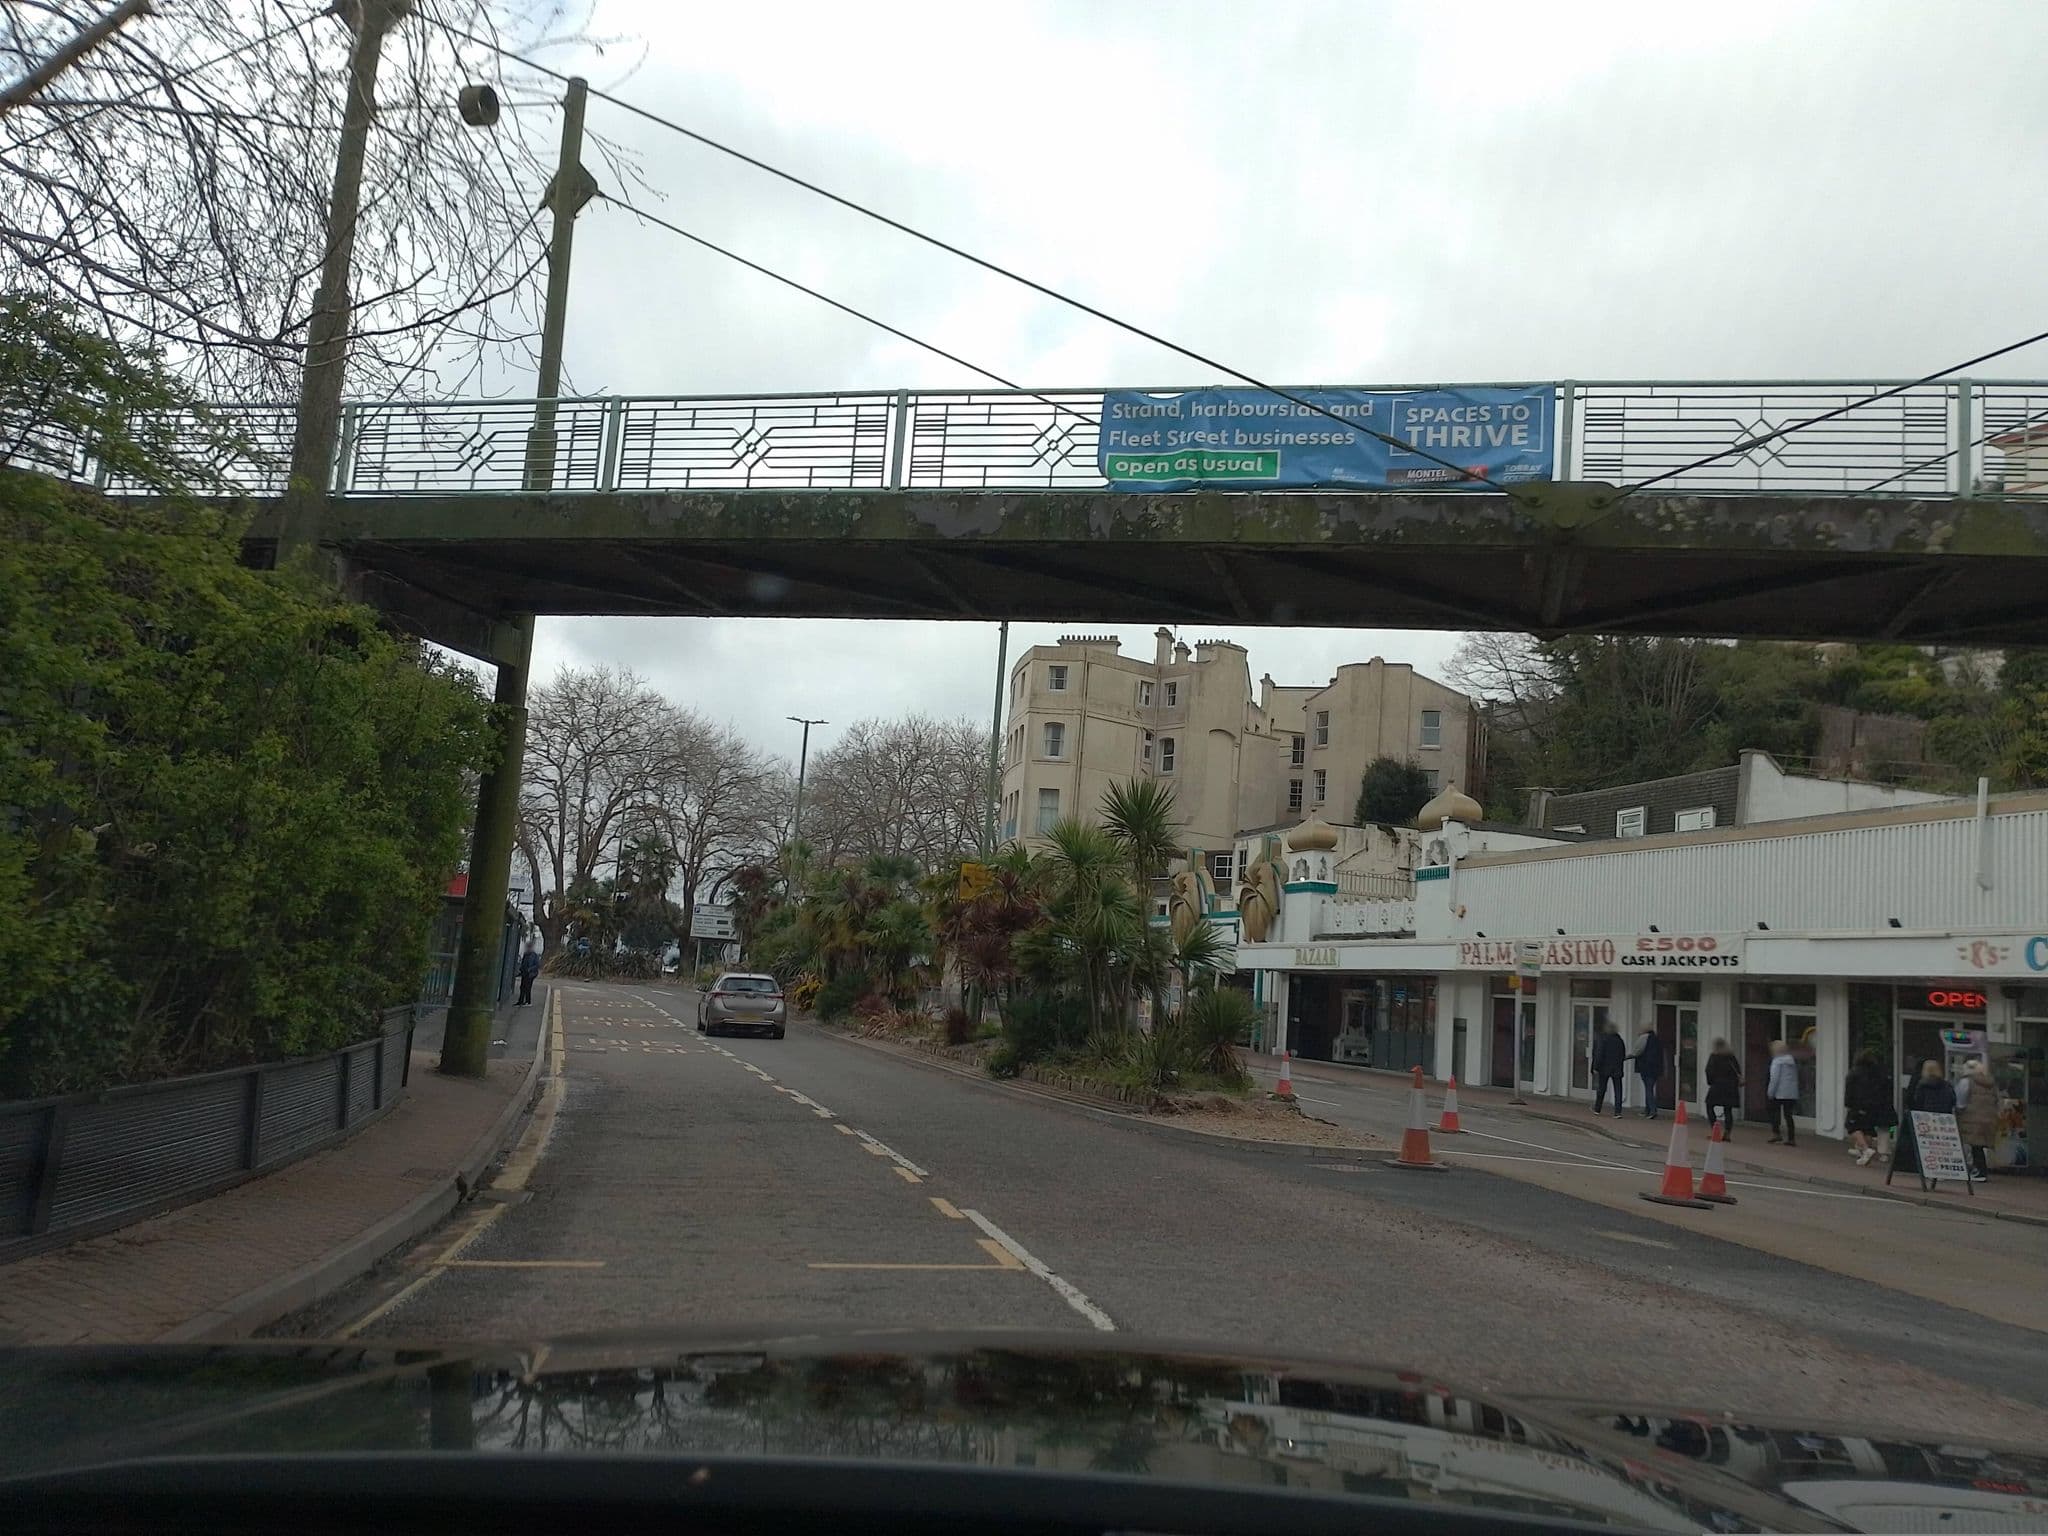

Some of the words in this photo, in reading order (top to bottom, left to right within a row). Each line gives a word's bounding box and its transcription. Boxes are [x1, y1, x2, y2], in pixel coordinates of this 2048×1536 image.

[1111, 400, 1185, 421] Strand,
[1191, 399, 1324, 418] harbourside
[1330, 399, 1373, 418] and
[1405, 406, 1492, 424] SPACES
[1498, 404, 1530, 420] TO
[1109, 430, 1161, 447] Fleet
[1167, 429, 1229, 447] Street
[1234, 428, 1355, 446] businesses
[1405, 424, 1530, 448] THRIVE
[1115, 459, 1169, 476] open
[1174, 457, 1198, 471] as
[1202, 456, 1263, 473] usual
[1407, 469, 1447, 479] MONTEL
[1459, 941, 1517, 965] PALM
[1538, 939, 1617, 966] ASINO
[1635, 936, 1717, 952] £500
[1295, 948, 1337, 966] BAZAAR
[1621, 955, 1656, 967] CASH
[1661, 955, 1739, 968] JACKPOTS
[1928, 991, 1988, 1009] OPEN
